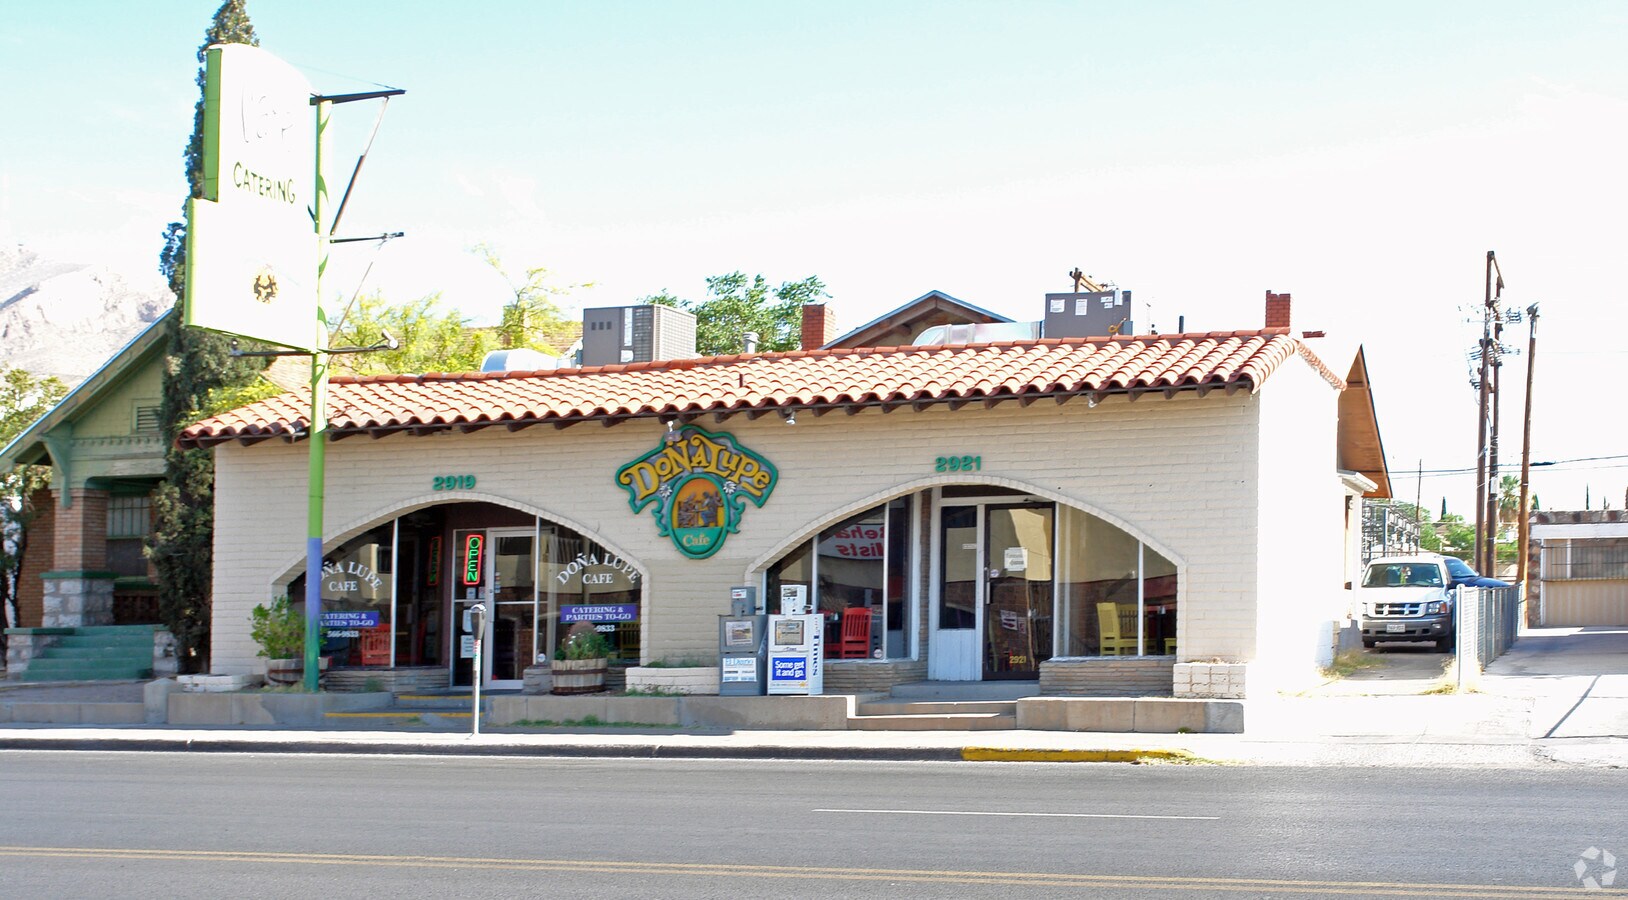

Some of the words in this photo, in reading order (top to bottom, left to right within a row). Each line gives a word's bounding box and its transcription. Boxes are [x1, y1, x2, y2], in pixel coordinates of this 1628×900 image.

[233, 161, 296, 204] CATERING
[935, 455, 981, 472] 2921
[433, 475, 476, 490] 2919
[682, 533, 710, 547] Cafe
[466, 537, 480, 582] OPEN
[556, 552, 599, 585] DOÑA
[603, 553, 640, 583] LUPE
[347, 561, 382, 591] LUPE
[582, 573, 614, 584] CAFE
[328, 581, 358, 592] CAFE
[572, 606, 616, 614] CATERING
[360, 612, 367, 620] &
[349, 619, 375, 627] TO-GO
[775, 660, 794, 669] Some
[794, 660, 804, 670] get
[1009, 655, 1027, 664] 2921
[776, 669, 781, 677] it
[781, 668, 794, 677] and
[794, 669, 804, 678] go.
